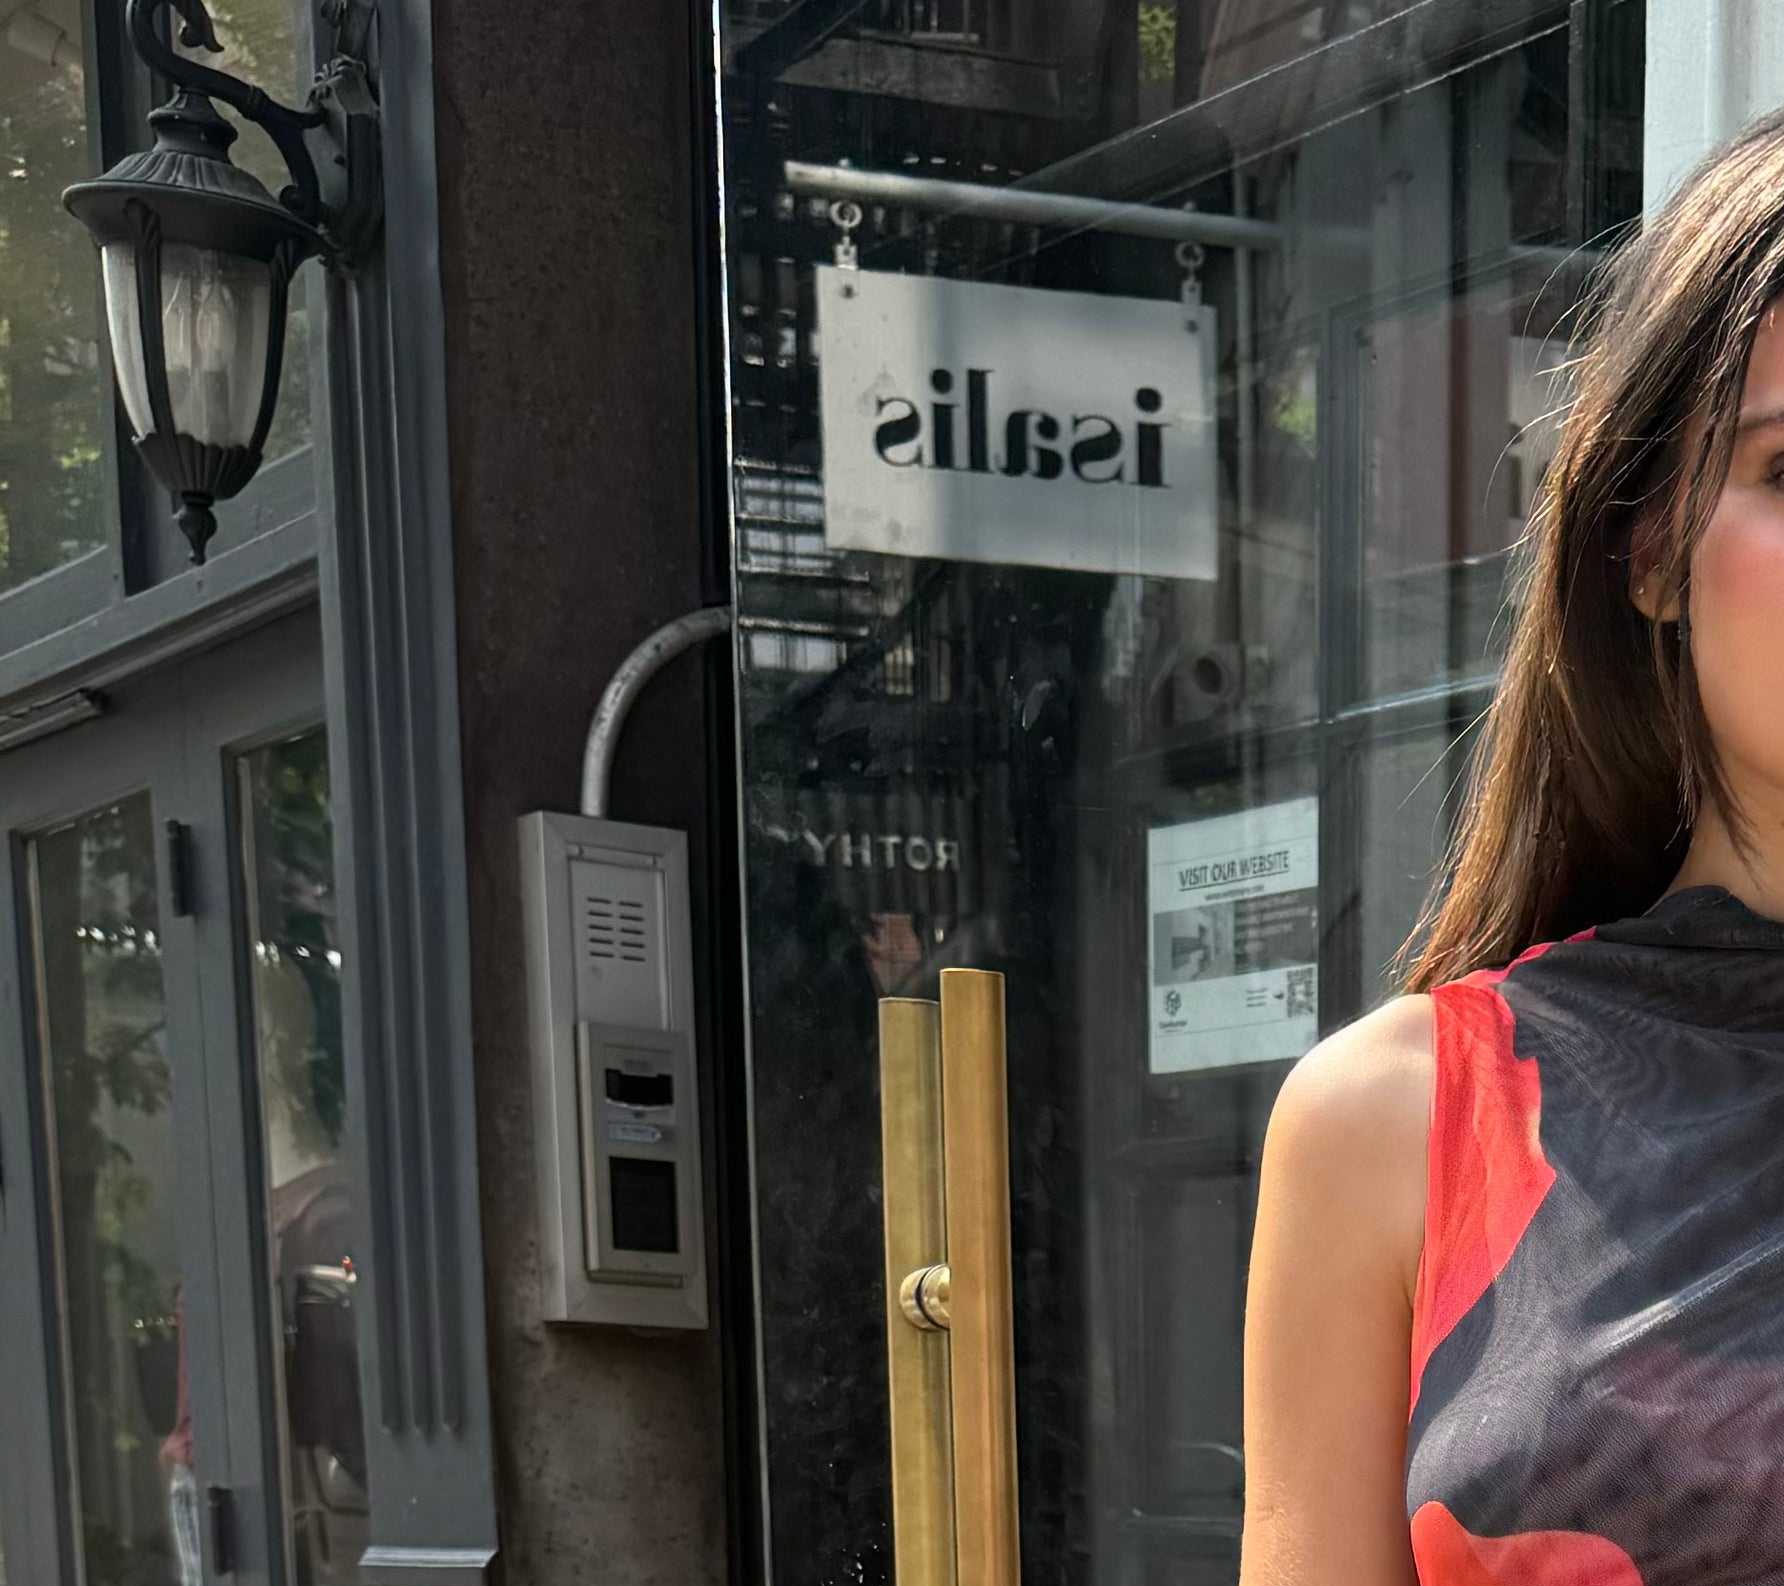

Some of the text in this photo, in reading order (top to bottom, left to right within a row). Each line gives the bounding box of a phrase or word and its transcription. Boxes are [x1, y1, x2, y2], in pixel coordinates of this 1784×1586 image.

[1178, 850, 1290, 887] VISIT OUR WEBSITE
